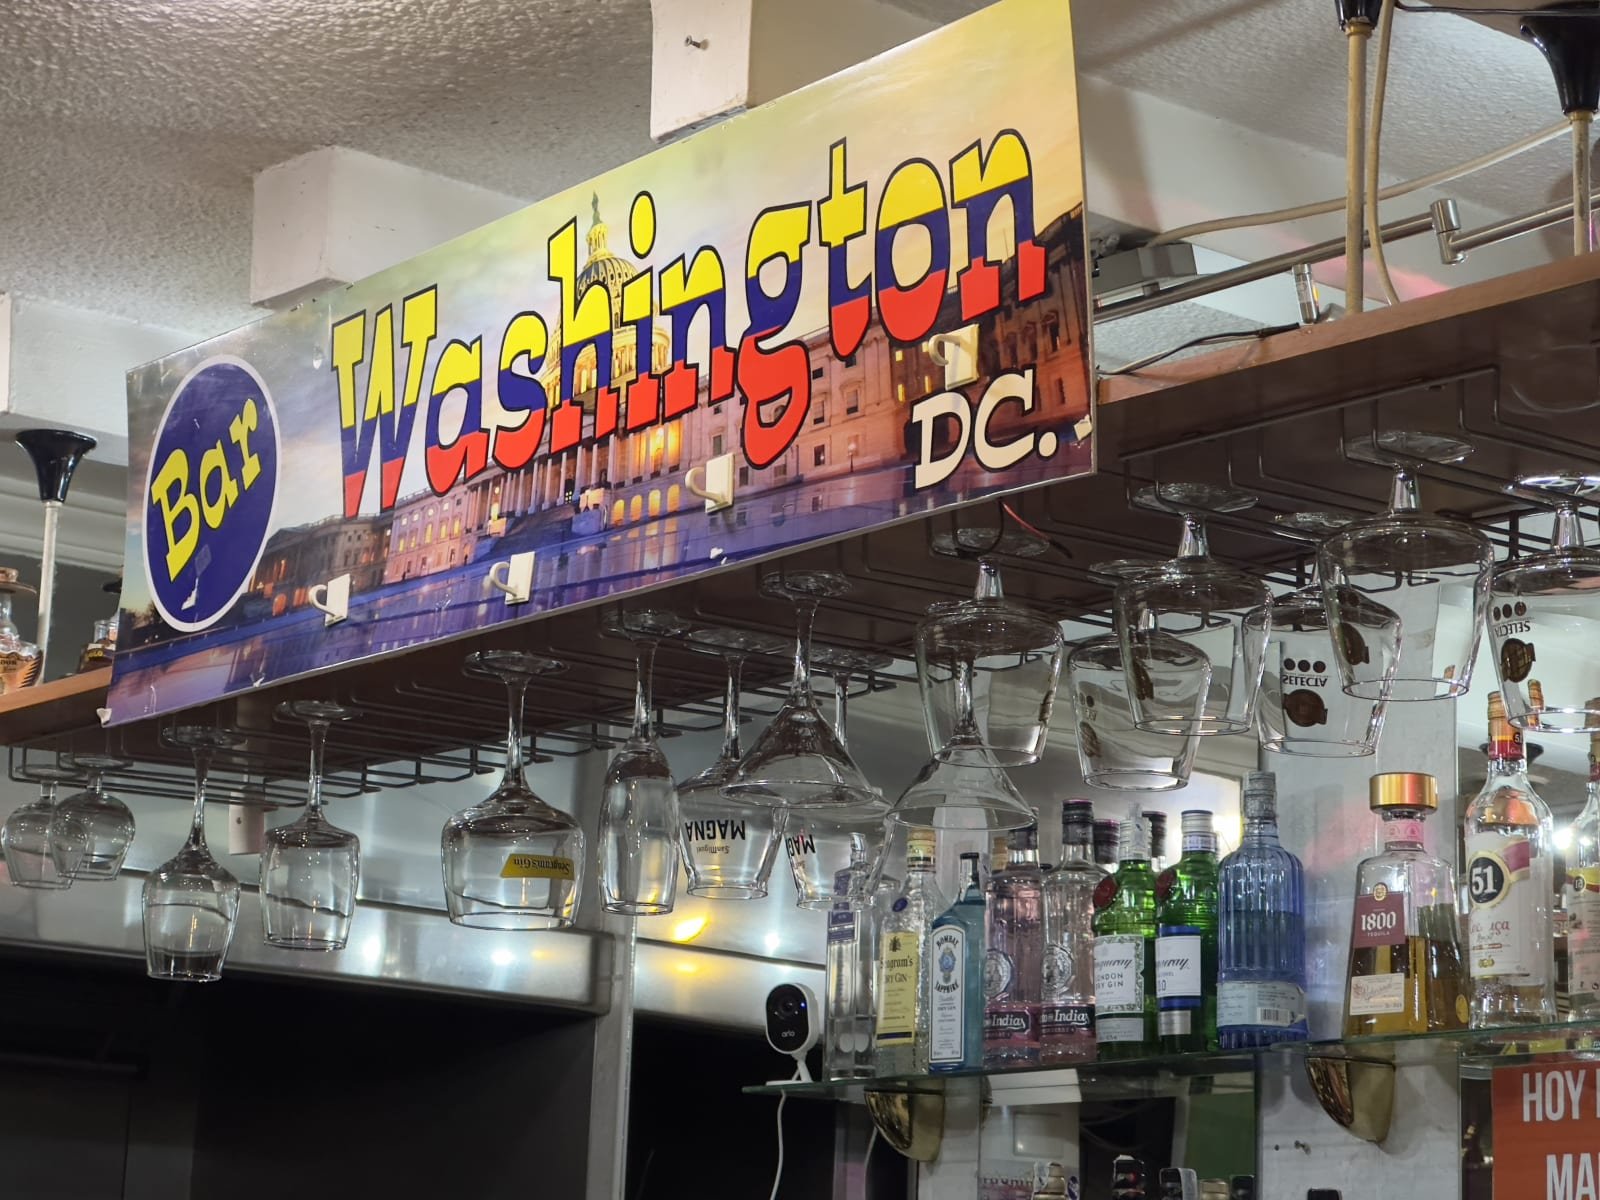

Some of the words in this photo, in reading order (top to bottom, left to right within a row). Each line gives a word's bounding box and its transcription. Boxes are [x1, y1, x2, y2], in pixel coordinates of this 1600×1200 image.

[331, 128, 1046, 518] Washington
[151, 397, 262, 582] Bar
[1493, 621, 1532, 638] SELECTA
[685, 820, 746, 842] MAGNA
[514, 857, 532, 869] Gin
[1470, 863, 1498, 894] 51
[1361, 911, 1397, 931] 1800
[936, 935, 959, 950] BOMBAY
[934, 981, 960, 993] SAPPHIRE
[1107, 980, 1124, 988] GIN
[781, 1030, 795, 1038] arlo
[1522, 1068, 1586, 1122] HOY
[1546, 1153, 1600, 1200] MA
